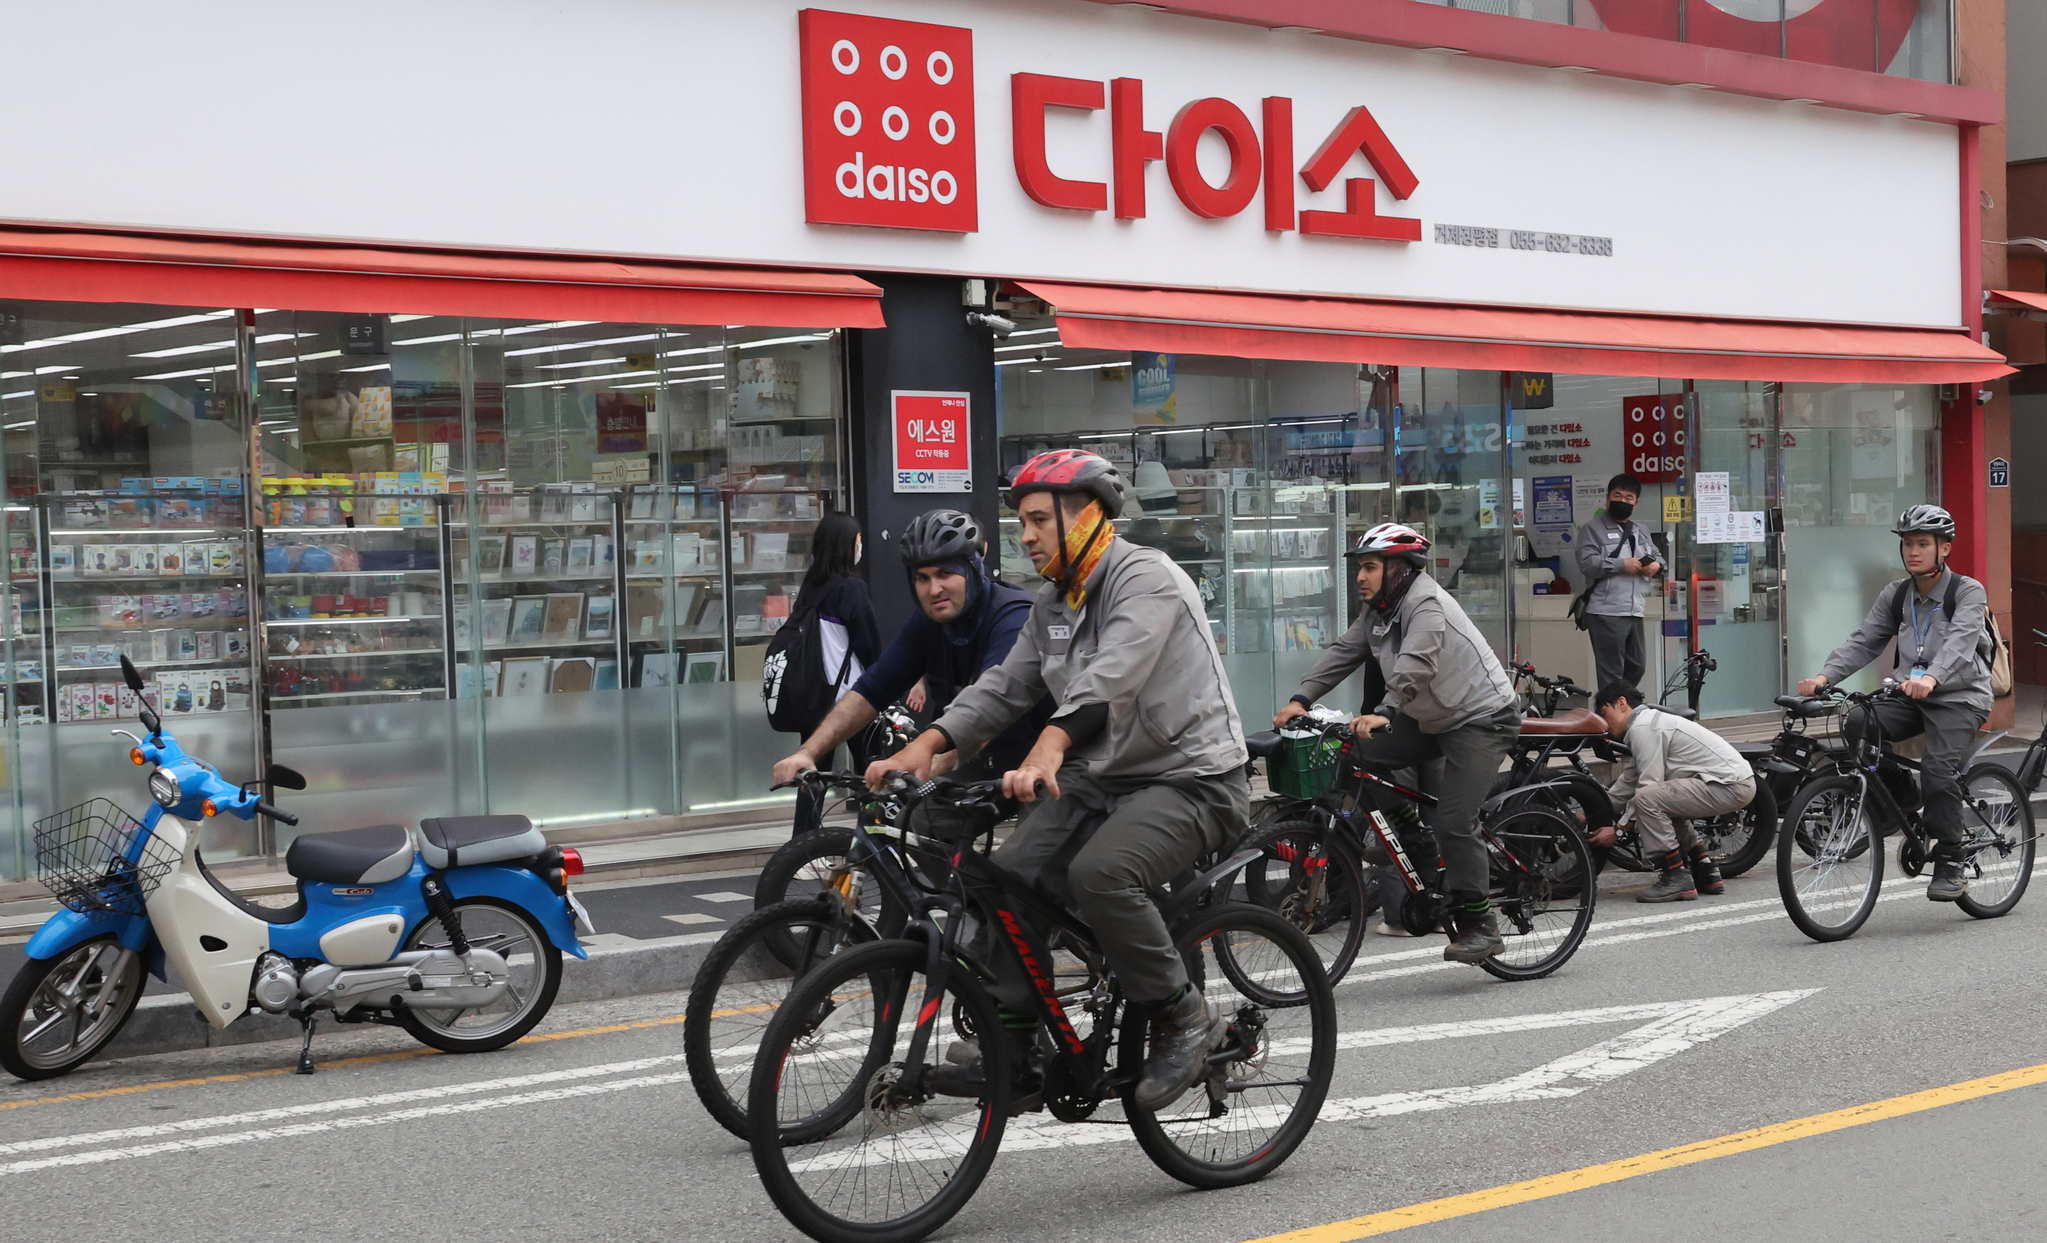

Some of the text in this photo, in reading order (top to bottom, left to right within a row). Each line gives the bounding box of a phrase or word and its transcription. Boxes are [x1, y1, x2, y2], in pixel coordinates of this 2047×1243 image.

[1011, 72, 1422, 242] 다이소
[835, 151, 958, 205] daiso
[1510, 230, 1613, 257] 055-632-8338
[1137, 366, 1170, 386] COOL
[606, 415, 638, 431] 층별안내
[907, 419, 956, 443] 에스원
[1526, 424, 1549, 435] 필요한
[1550, 424, 1558, 434] 건
[915, 449, 950, 458] CCTV 작동중
[1528, 454, 1558, 464] 어디든지
[1632, 452, 1685, 473] daiso
[615, 465, 624, 477] 10
[897, 472, 934, 483] SECOM
[1992, 472, 2006, 483] 17
[1370, 809, 1425, 892] BIPER
[997, 909, 1085, 1055] MAGENTA
